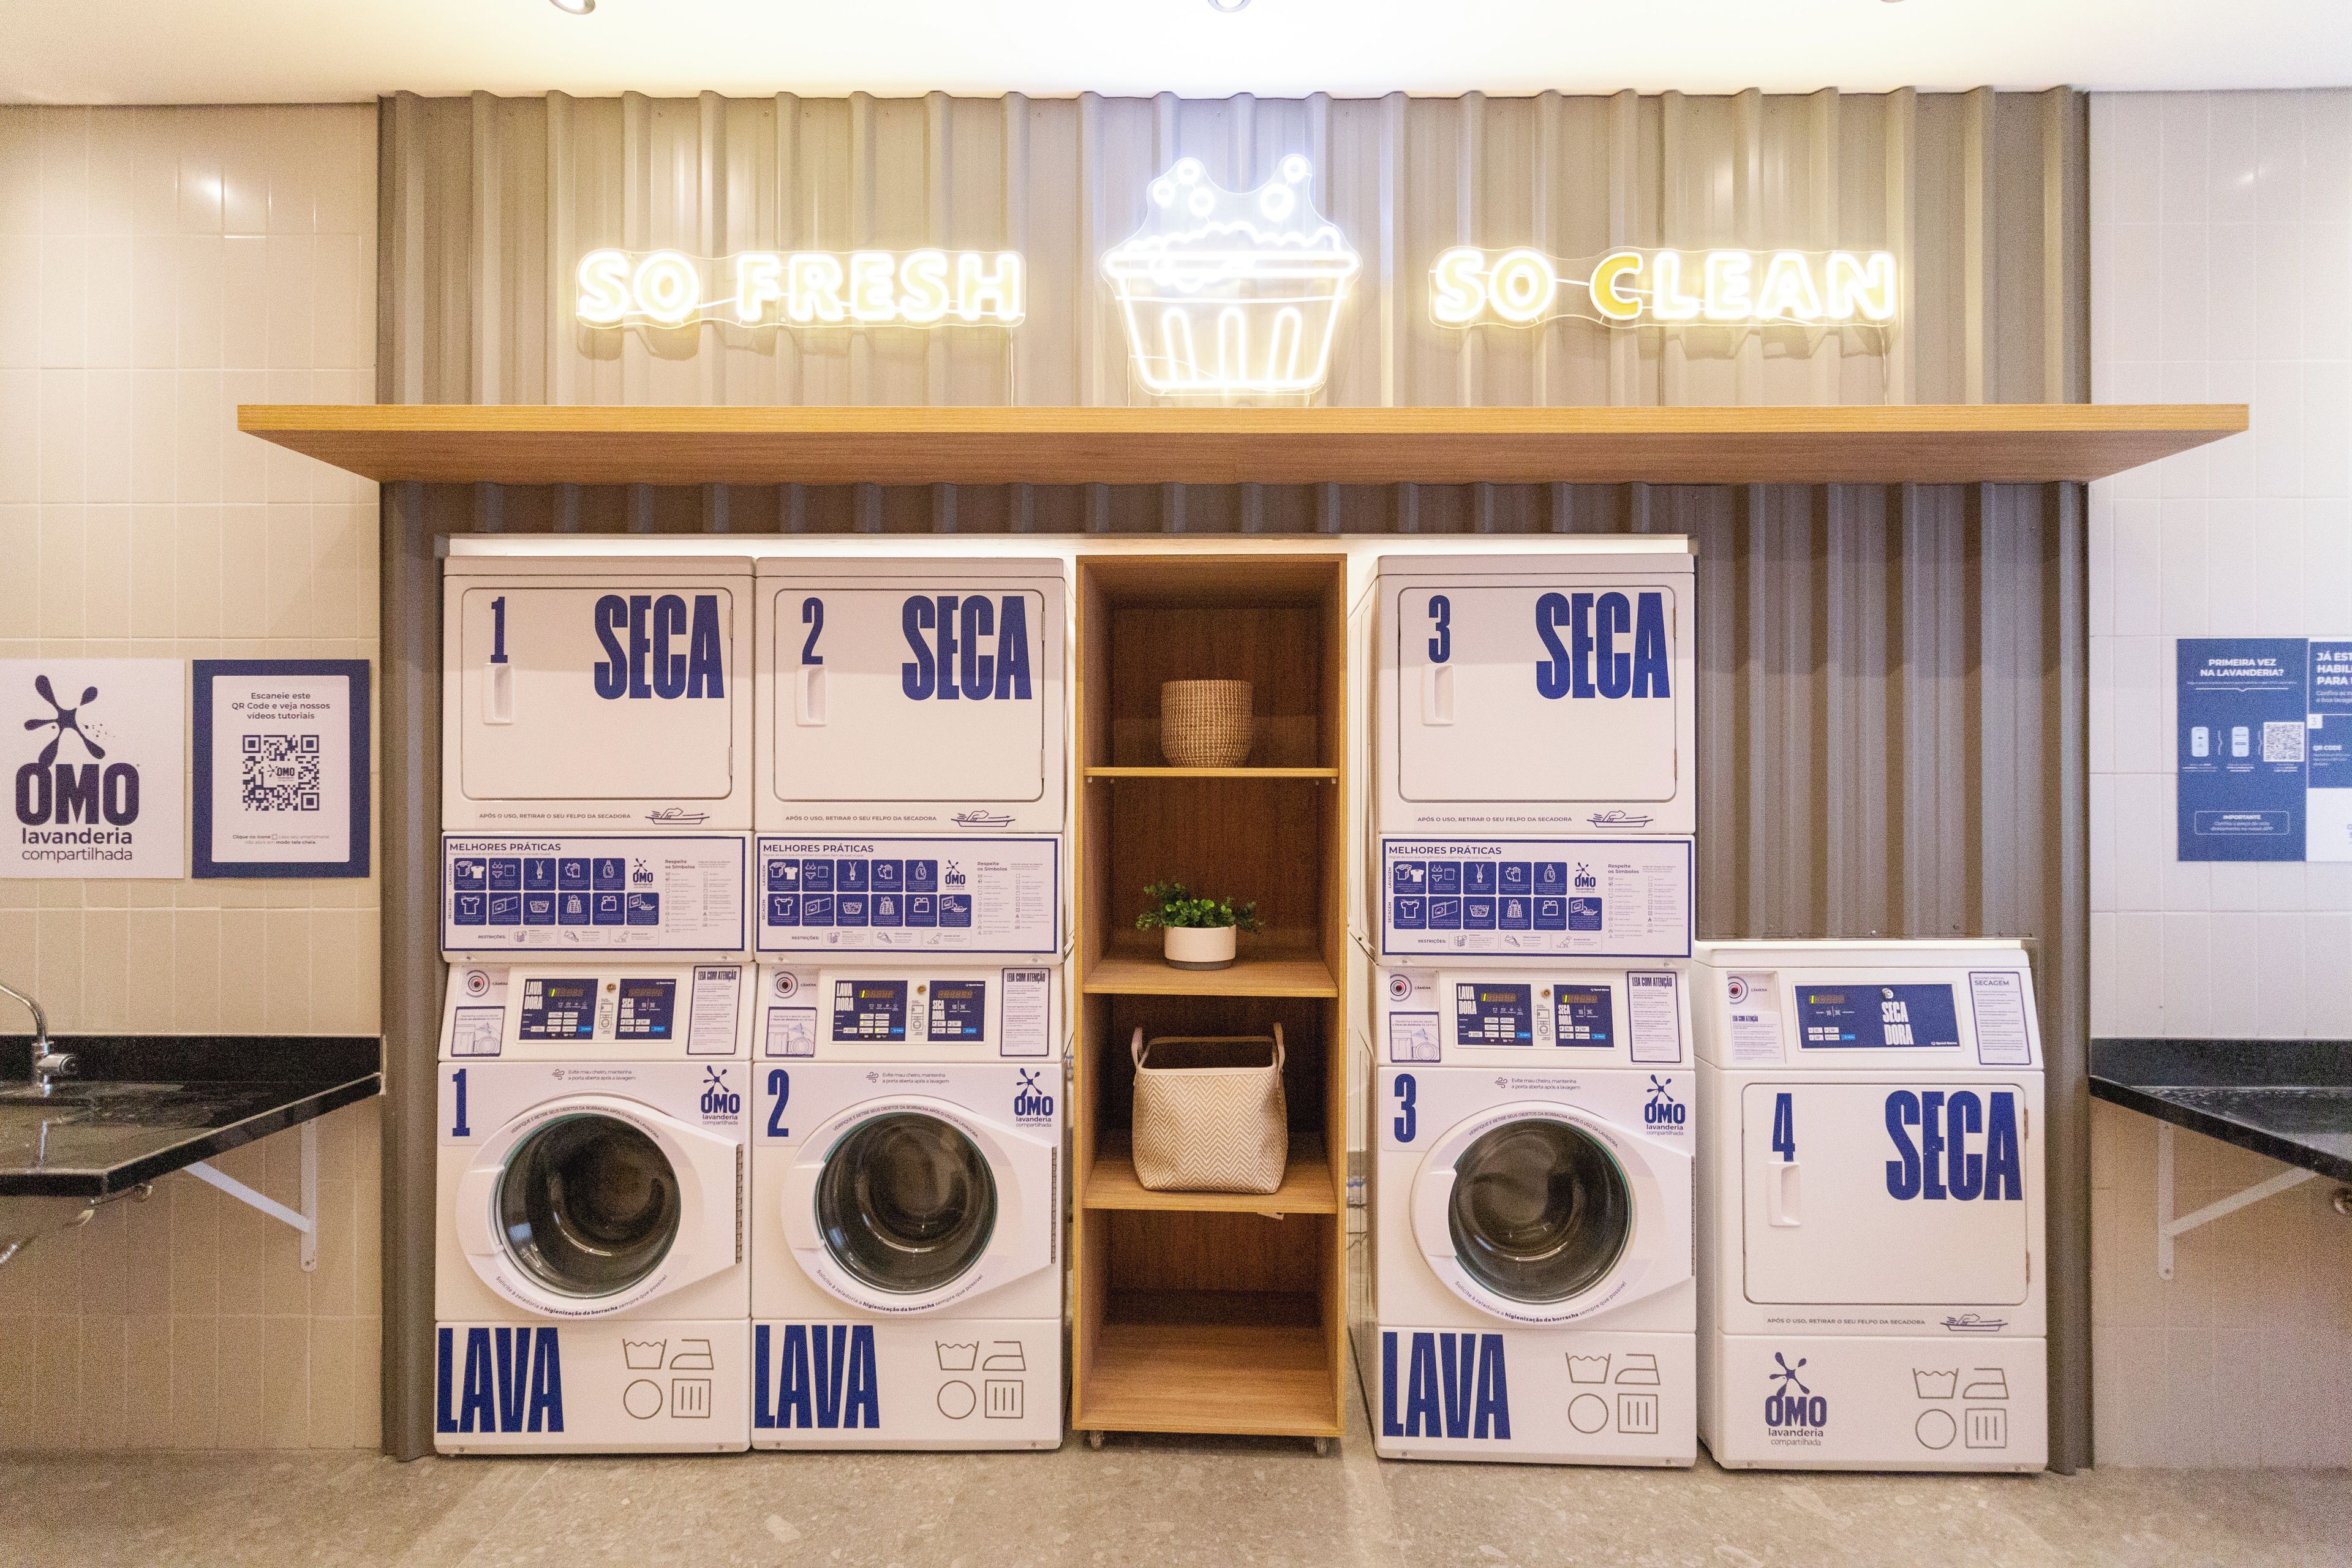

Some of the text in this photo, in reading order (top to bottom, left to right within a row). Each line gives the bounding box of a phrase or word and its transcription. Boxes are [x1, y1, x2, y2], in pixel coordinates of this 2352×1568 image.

[578, 252, 1022, 323] SO FRESH
[1435, 250, 1895, 322] SO CLEAN
[491, 597, 508, 663] 1
[802, 597, 823, 665] 2
[1428, 595, 1450, 663] 3
[594, 594, 725, 699] SECA
[902, 595, 1032, 700] SECA
[1536, 592, 1670, 699] SECA
[2316, 676, 2348, 685] PARA
[276, 767, 295, 777] OMO
[15, 763, 139, 826] OMO
[22, 827, 132, 845] lavanderia
[510, 842, 561, 851] PRÁTICAS
[823, 843, 873, 852] PRÁTICAS
[21, 848, 133, 864] compartilhada
[1450, 845, 1502, 854] PRÁTICAS
[633, 872, 653, 883] OMO
[945, 874, 966, 884] OMO
[1575, 876, 1596, 888] OMO
[1458, 986, 1474, 1000] LAVA
[1882, 1001, 1909, 1022] SECA
[1884, 1024, 1914, 1045] DORA
[453, 1068, 470, 1137] 1
[701, 1093, 740, 1114] OMO
[767, 1069, 790, 1137] 2
[1014, 1095, 1054, 1116] OMO
[1394, 1073, 1417, 1143] 3
[1644, 1102, 1686, 1124] OMO
[1773, 1093, 1795, 1162] 4
[1885, 1090, 2023, 1200] SECA
[1505, 1311, 1543, 1324] higienização
[1552, 1313, 1579, 1322] borracha
[1580, 1303, 1599, 1316] sempre
[437, 1327, 564, 1433] LAVA
[754, 1324, 880, 1429] LAVA
[1382, 1332, 1512, 1439] LAVA
[1765, 1396, 1826, 1427] OMO
[1768, 1428, 1823, 1436] lavanderia
